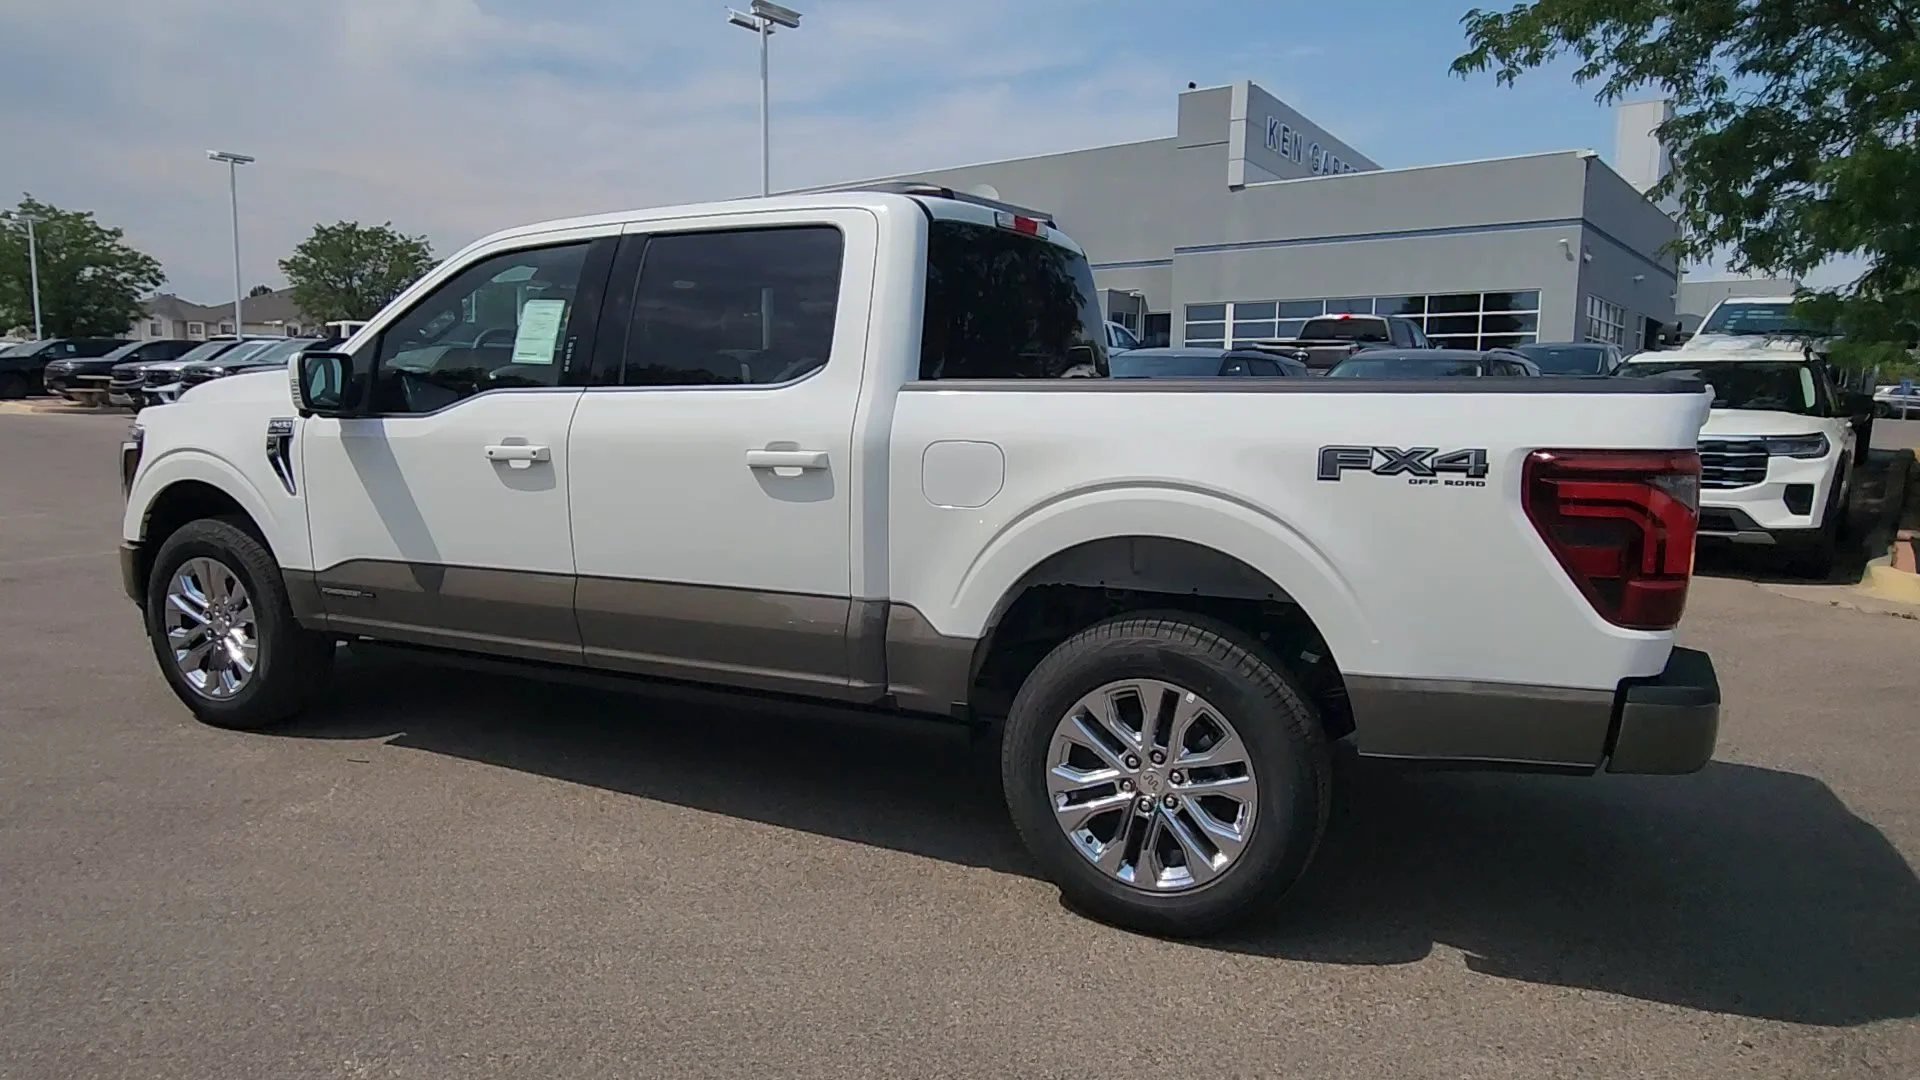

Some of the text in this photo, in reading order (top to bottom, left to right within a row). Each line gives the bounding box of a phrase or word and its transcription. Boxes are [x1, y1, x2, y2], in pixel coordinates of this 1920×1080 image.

[1266, 115, 1358, 175] KEN GAR
[1317, 445, 1489, 481] FX4
[1408, 478, 1486, 488] OFF ROAD
